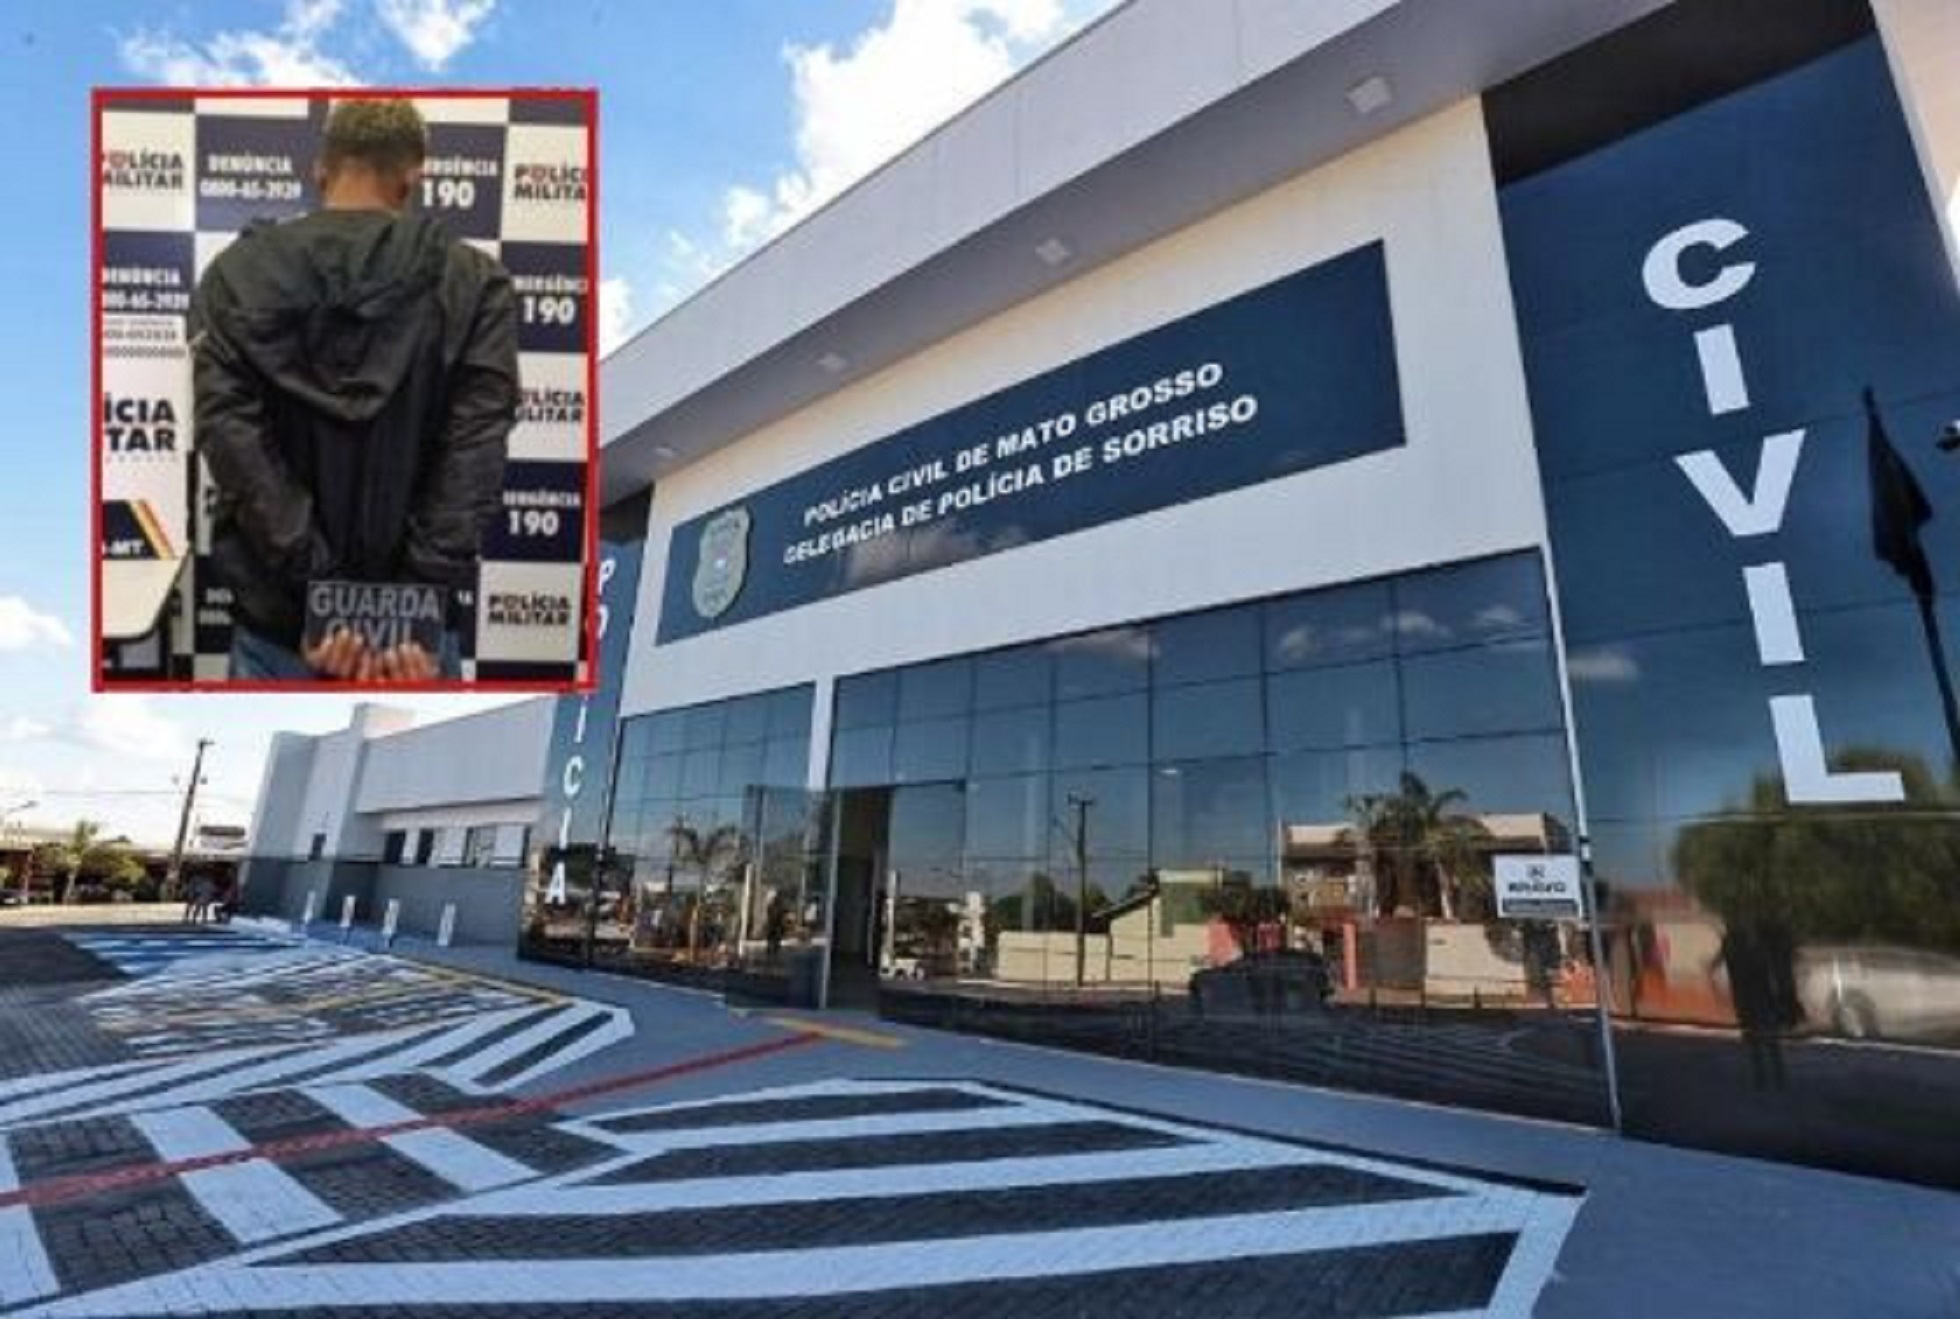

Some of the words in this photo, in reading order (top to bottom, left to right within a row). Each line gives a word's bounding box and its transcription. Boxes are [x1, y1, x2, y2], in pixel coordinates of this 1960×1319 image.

[423, 180, 476, 209] 190
[522, 296, 576, 324] 190
[104, 427, 176, 451] TAR
[803, 483, 883, 527] POLÍCIA
[888, 461, 949, 494] CIVIL
[956, 443, 990, 473] DE
[997, 413, 1077, 458] MATO
[1084, 362, 1223, 426] GROSSO
[901, 499, 932, 526] DE
[937, 464, 1044, 515] POLÍCIA
[1052, 447, 1094, 478] DE
[1102, 394, 1259, 463] SORRISO
[509, 511, 560, 536] 190
[1641, 217, 1906, 804] CIVIL
[310, 586, 441, 620] GUARDA
[487, 590, 572, 611] POLÍCIA
[488, 610, 570, 626] MILITAR
